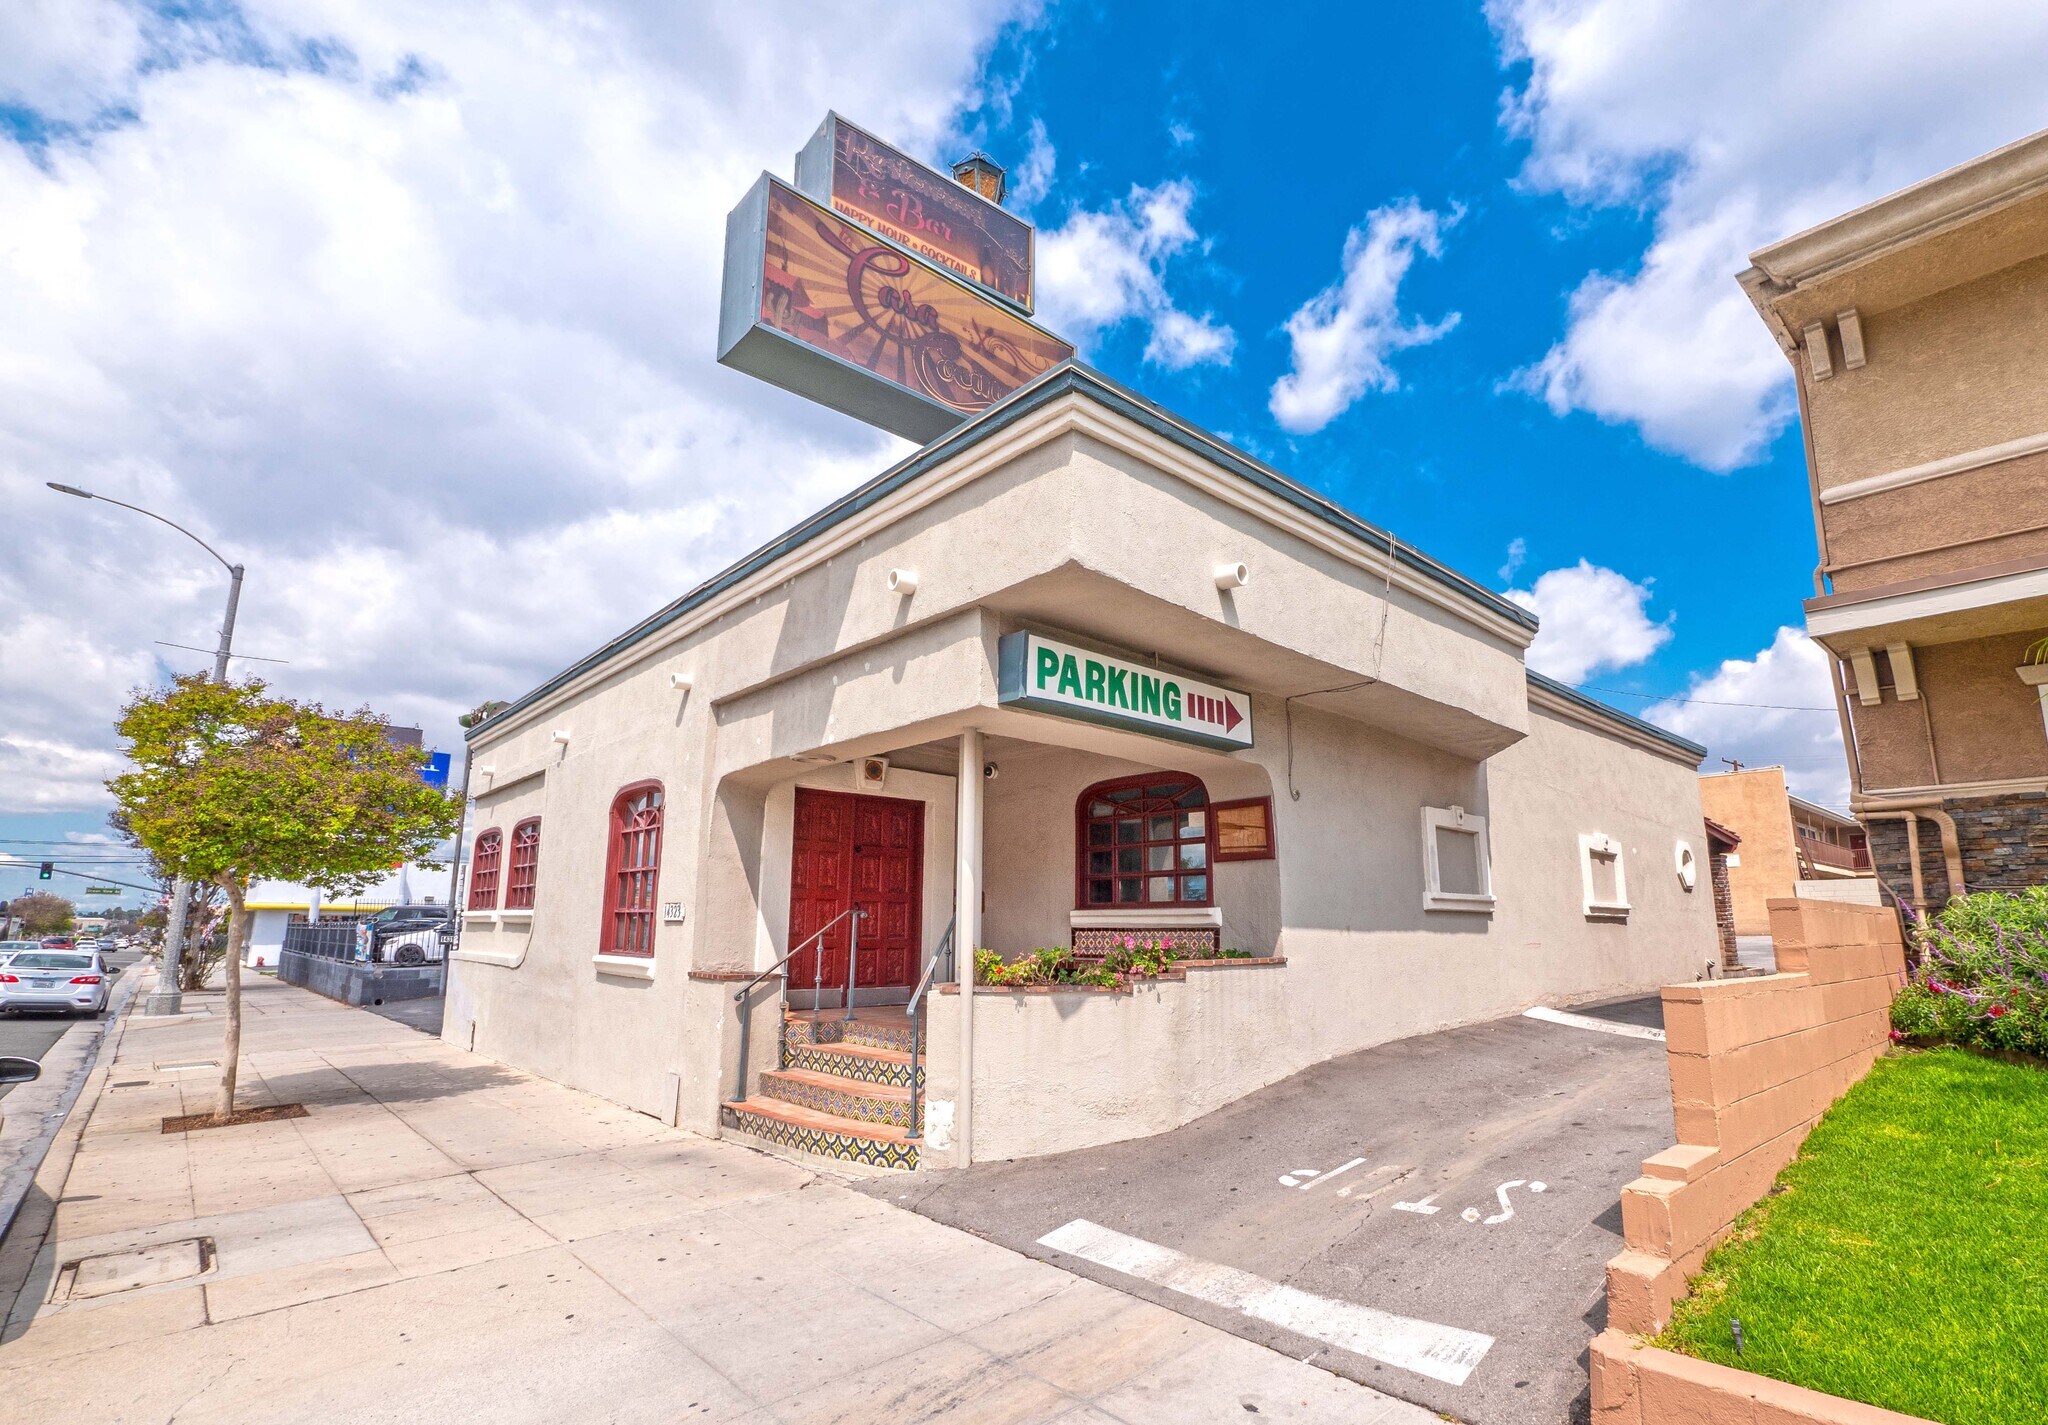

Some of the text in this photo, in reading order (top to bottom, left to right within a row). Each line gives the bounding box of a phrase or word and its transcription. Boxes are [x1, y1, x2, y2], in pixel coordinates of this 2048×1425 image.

[834, 202, 978, 280] HAPPY HOUR COCKTAILS
[886, 190, 952, 241] Bar
[816, 222, 940, 344] Casa
[911, 331, 1015, 412] Cocin
[1036, 645, 1182, 722] PARKING
[663, 905, 681, 918] 14323
